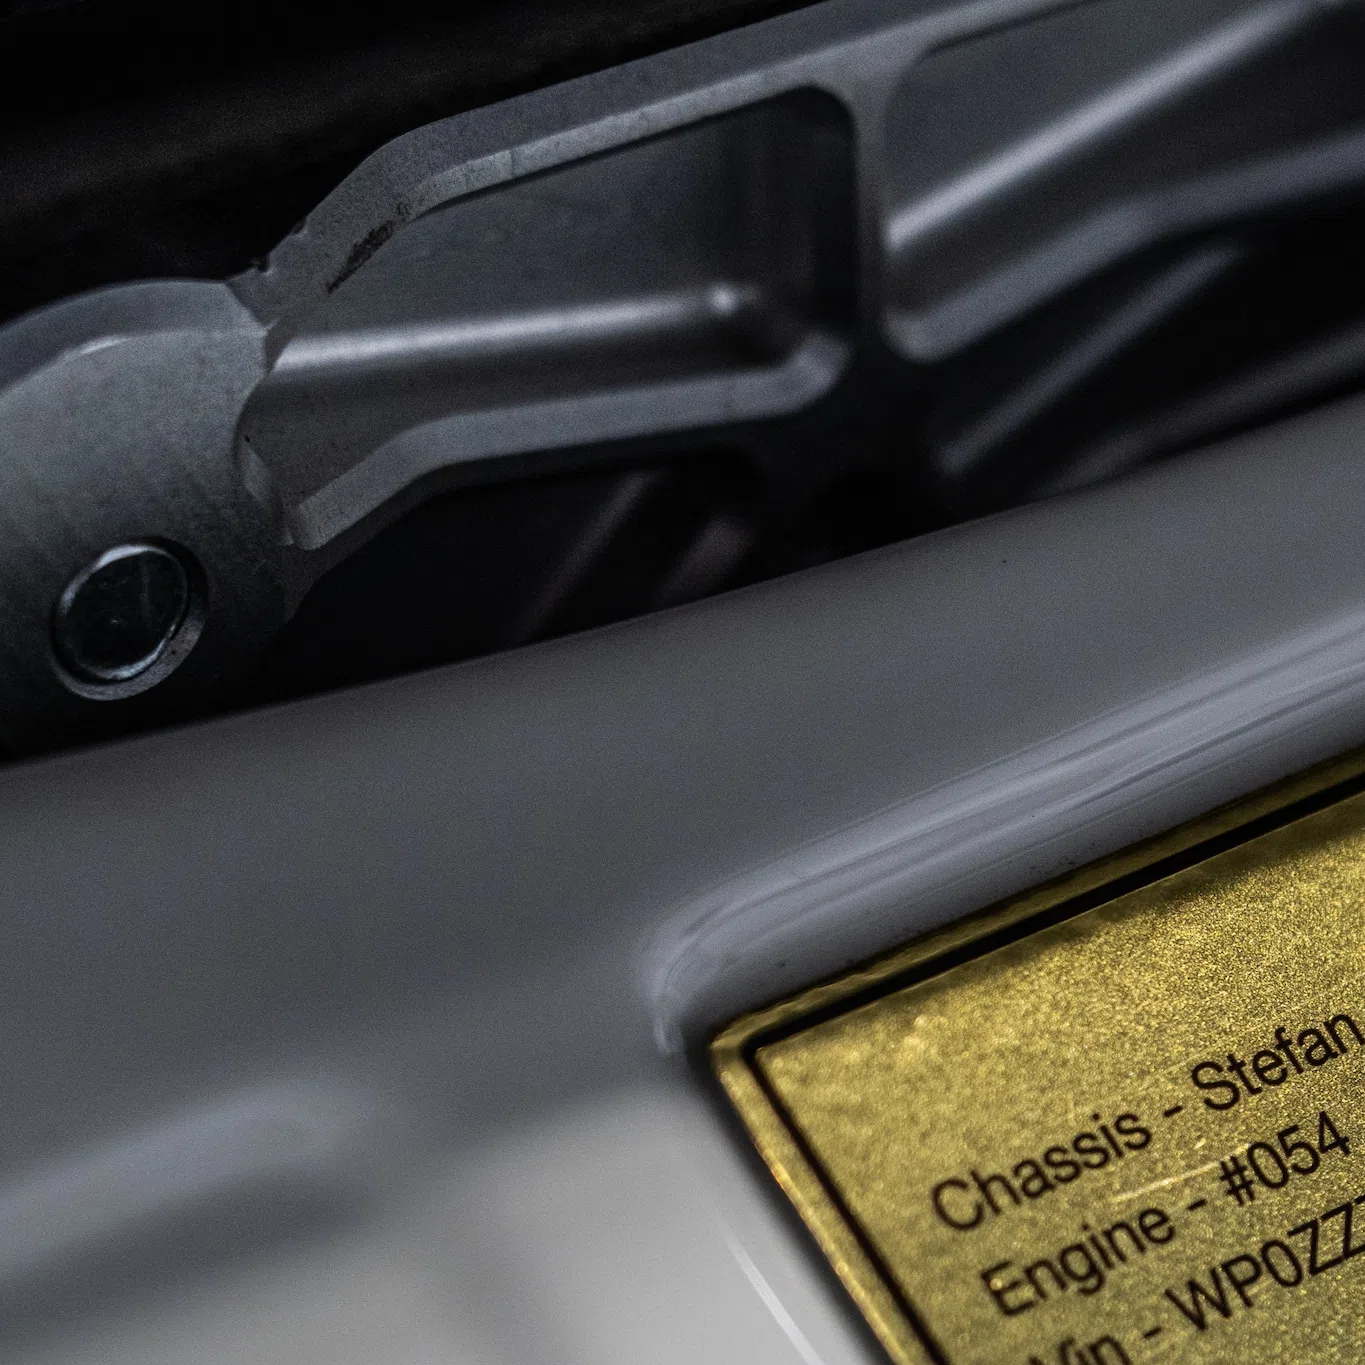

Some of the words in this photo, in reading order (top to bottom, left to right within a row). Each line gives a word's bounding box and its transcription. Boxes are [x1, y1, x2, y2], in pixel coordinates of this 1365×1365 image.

[931, 1111, 1154, 1232] Chassis
[1164, 1103, 1184, 1119] -
[979, 1207, 1176, 1318] Engine
[1187, 1200, 1207, 1214] -
[1218, 1111, 1352, 1206] #054
[1142, 1326, 1163, 1341] -
